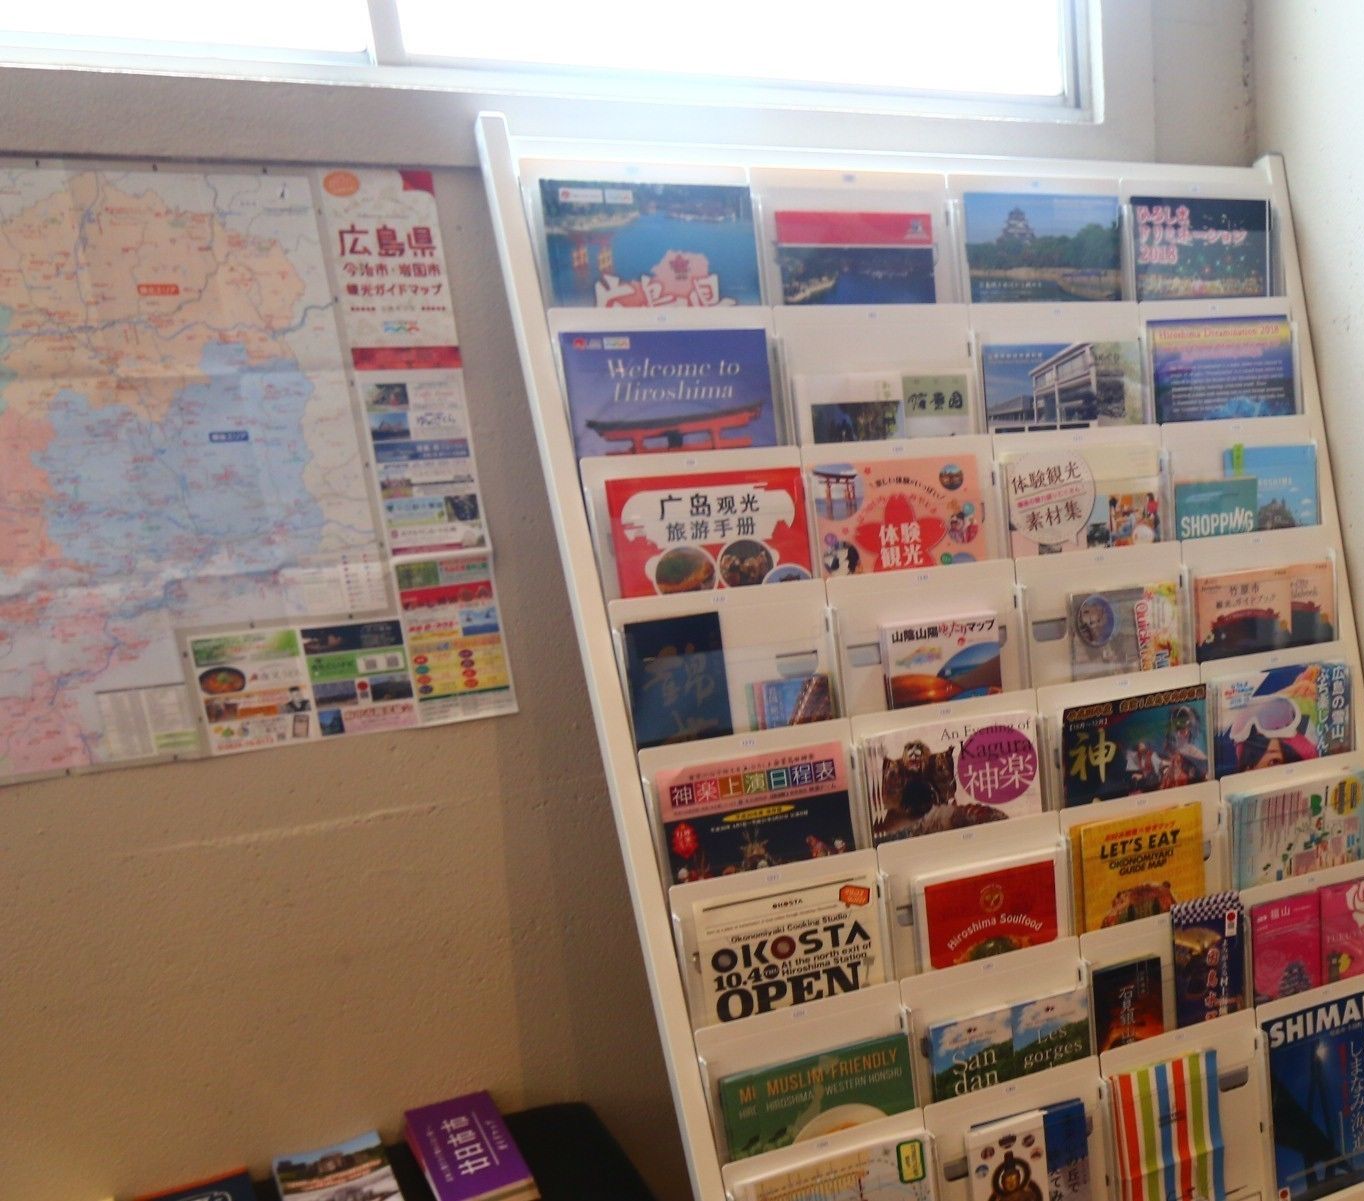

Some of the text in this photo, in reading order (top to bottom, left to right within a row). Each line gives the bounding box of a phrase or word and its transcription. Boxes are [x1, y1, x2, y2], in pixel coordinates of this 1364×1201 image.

[338, 224, 437, 257] 広島県
[607, 358, 741, 379] Welcome to
[612, 380, 734, 402] Hiroshima
[1011, 460, 1082, 495] 体験観光
[659, 494, 760, 521] 广岛观光
[1025, 499, 1083, 532] 素材集
[1180, 505, 1254, 538] SHOPPING
[665, 517, 757, 542] 旅游手册
[878, 520, 921, 547] 体験
[880, 543, 924, 568] 観光
[940, 727, 961, 741] An
[1017, 718, 1032, 732] of
[958, 737, 1034, 763] Kagura
[1068, 727, 1118, 784] 神
[670, 759, 837, 808] 神楽上演日程表
[963, 753, 1035, 799] 神楽
[1100, 837, 1143, 860] LET'S
[1148, 828, 1181, 850] EAT
[1108, 847, 1175, 870] OKONOMIYAKI
[731, 926, 785, 944] Okonomiyaki
[787, 919, 821, 934] Cooking
[822, 911, 848, 924] Studio
[946, 912, 1044, 950] Hiroshima Soulfood
[711, 919, 871, 973] OKOSTA
[781, 941, 872, 970] At the north exit of
[713, 966, 763, 992] 10.4
[781, 951, 868, 977] Hiroshima Station
[715, 961, 862, 1021] OPEN
[1037, 1026, 1068, 1045] Les
[952, 1046, 998, 1076] San
[1023, 1039, 1083, 1069] gorges
[766, 1068, 825, 1096] MUSLIM
[830, 1047, 898, 1080] FRIENDLY
[954, 1068, 1000, 1095] dan
[765, 1089, 815, 1113] HIROSHIMA
[825, 1077, 867, 1096] WESTERN
